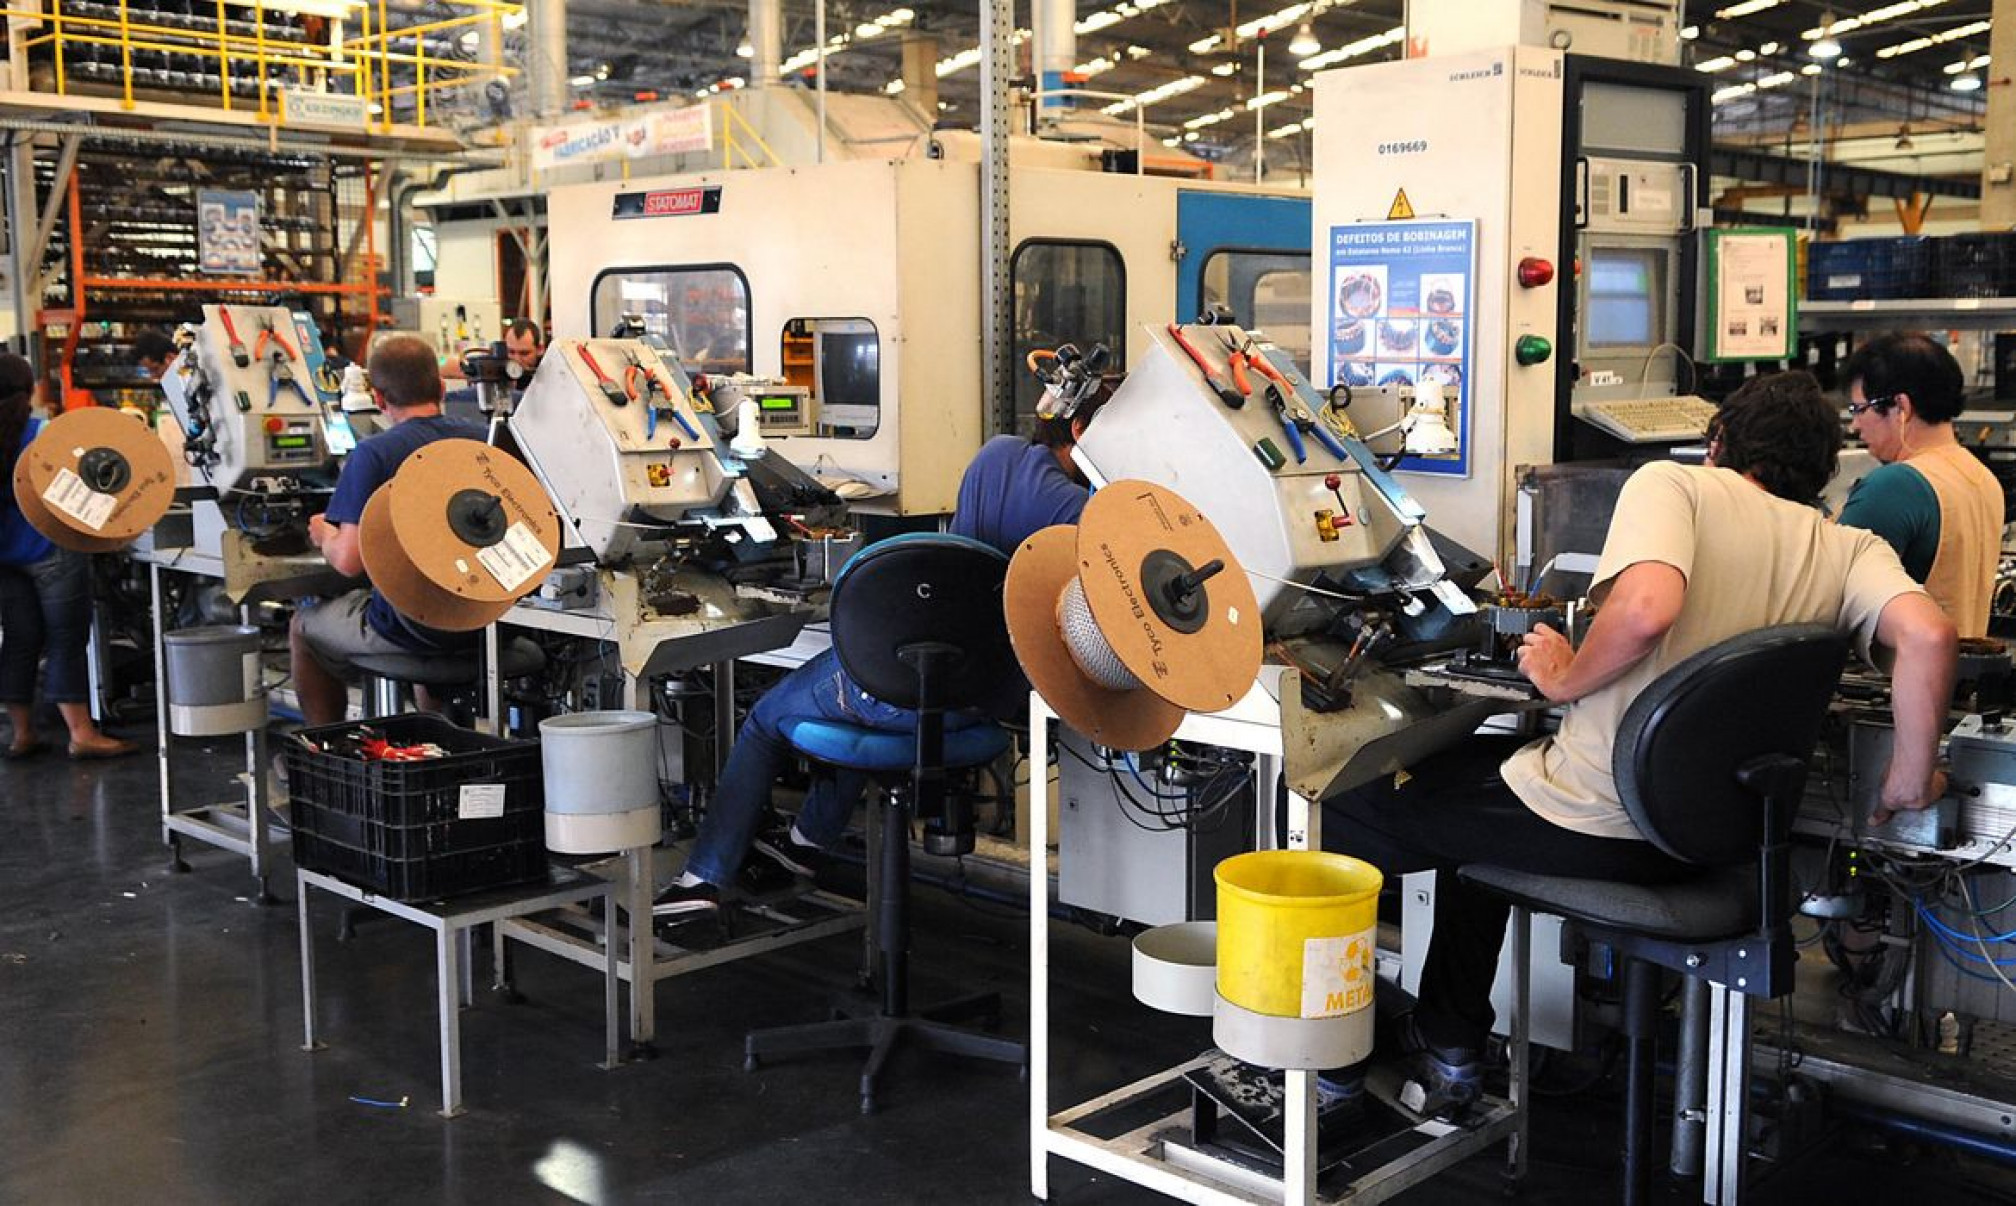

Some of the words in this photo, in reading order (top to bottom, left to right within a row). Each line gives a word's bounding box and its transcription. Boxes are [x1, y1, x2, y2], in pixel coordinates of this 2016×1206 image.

[1378, 140, 1428, 155] 0169669
[648, 193, 700, 212] STATOMAT
[1336, 231, 1385, 244] DEFEITOS
[1386, 231, 1400, 243] DE
[1403, 229, 1467, 243] BOBINAGEM
[1101, 542, 1145, 619] Electronics
[1143, 621, 1163, 657] Tyco
